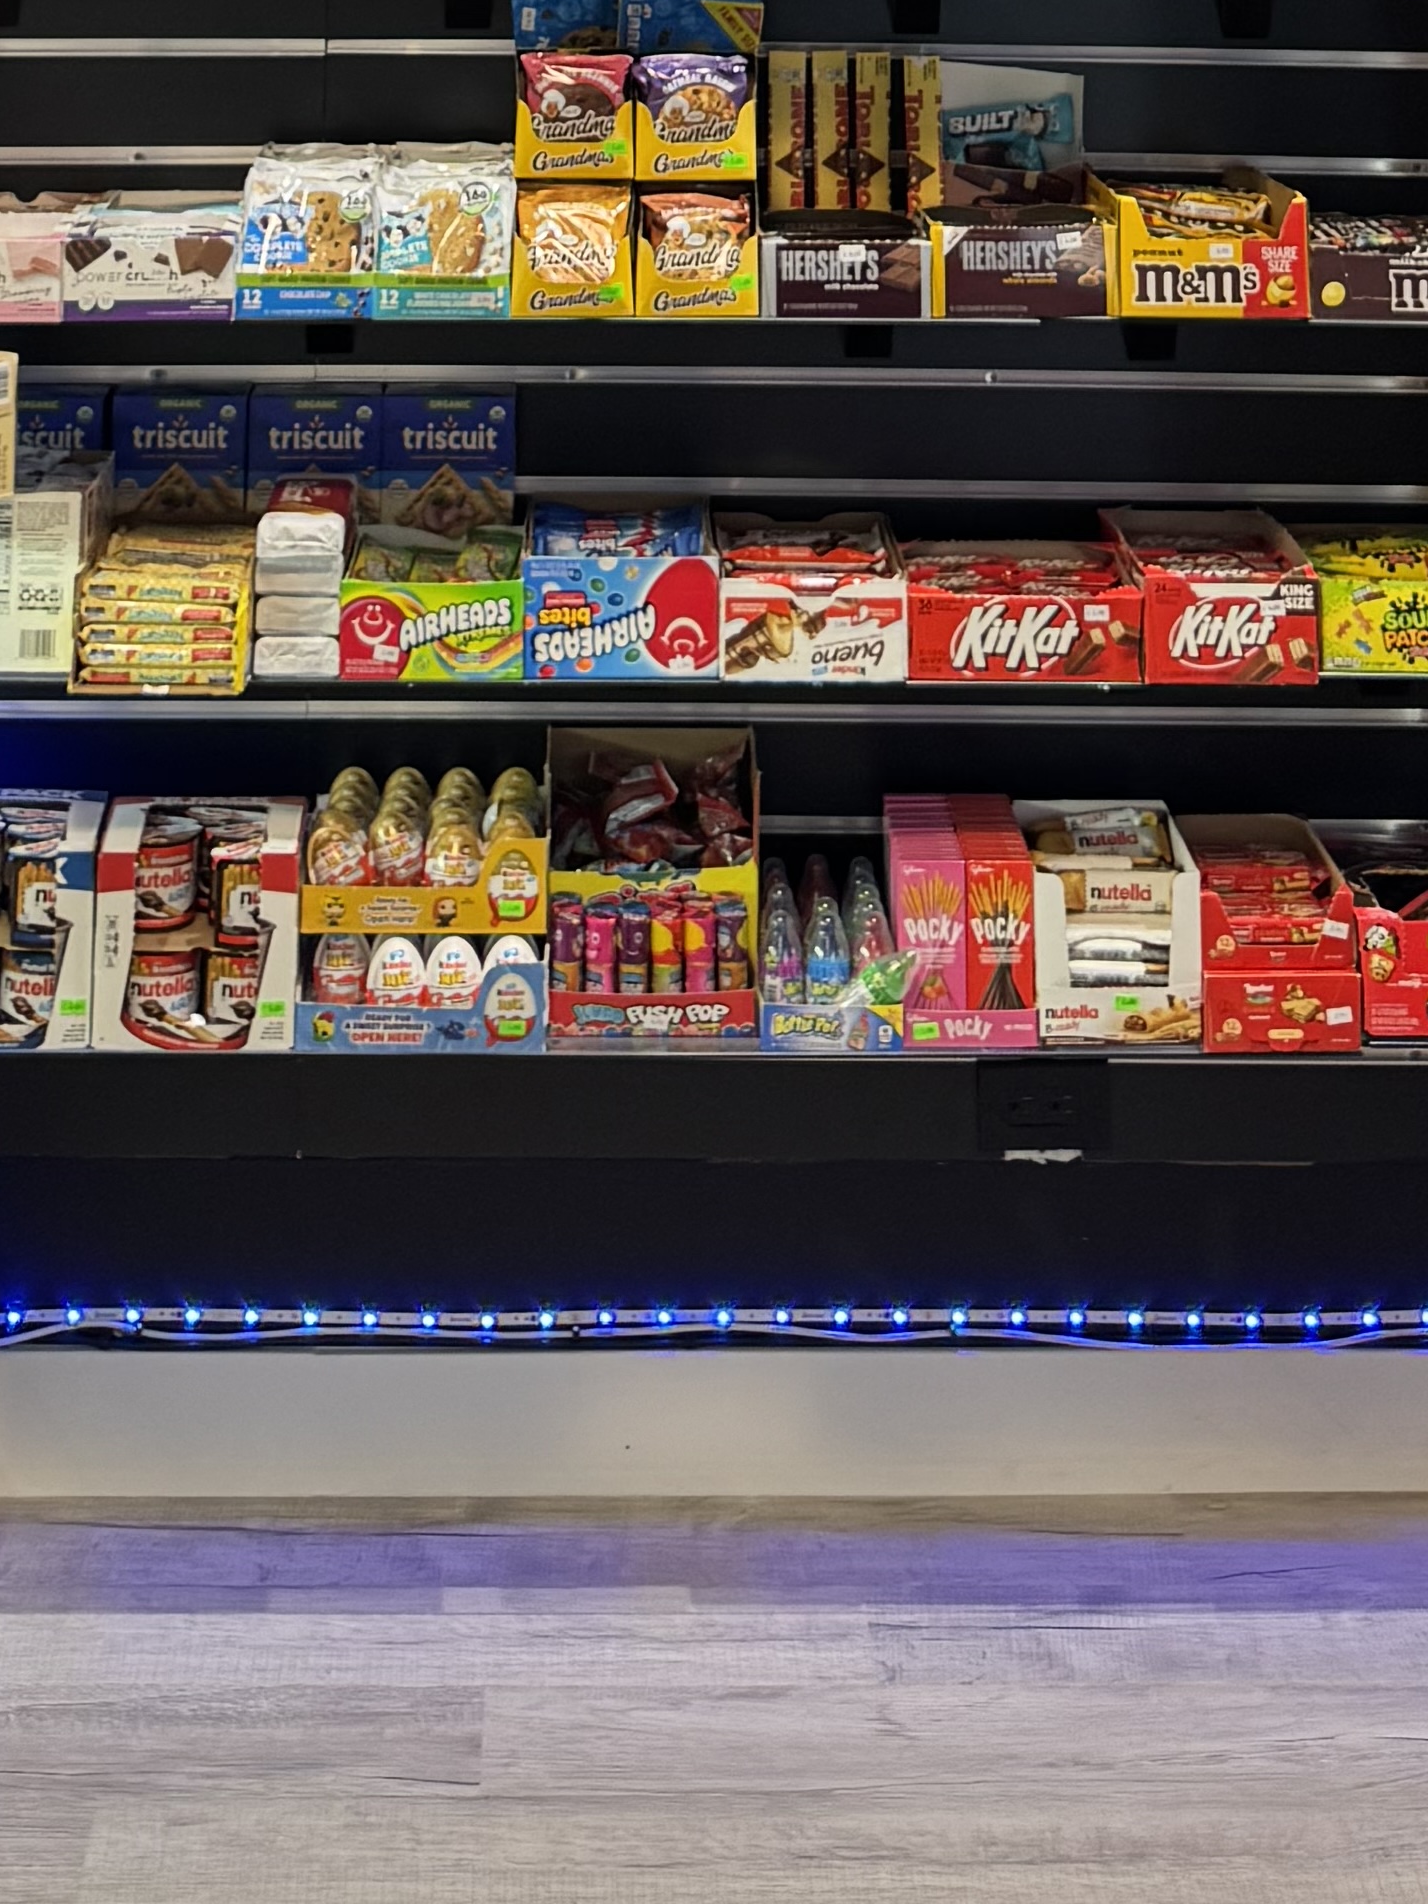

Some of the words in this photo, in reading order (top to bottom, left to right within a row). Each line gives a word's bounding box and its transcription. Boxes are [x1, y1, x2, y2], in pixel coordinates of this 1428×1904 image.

[949, 110, 1013, 133] BUILT
[962, 241, 1057, 270] HERSHEY'S
[1131, 247, 1184, 259] peanut
[1260, 245, 1299, 260] SHARE
[1267, 259, 1293, 274] SIZE
[242, 289, 262, 304] 12
[380, 289, 398, 304] 12
[132, 423, 229, 451] triscuit
[269, 423, 364, 451] triscuit
[403, 423, 497, 451] triscuit
[1280, 583, 1313, 597] KING
[1284, 595, 1314, 610] SIZE
[400, 599, 511, 650] AIRHEADS
[539, 607, 591, 628] bites
[534, 602, 656, 663] AIRHEADS
[952, 604, 1079, 672] KitKat
[811, 640, 885, 667] bueno
[1078, 830, 1138, 849] nutella
[1090, 883, 1152, 902] nutella
[130, 977, 197, 997] nutella
[626, 1006, 681, 1025] PUSH
[685, 1004, 729, 1022] POP
[1044, 1003, 1099, 1021] nutella
